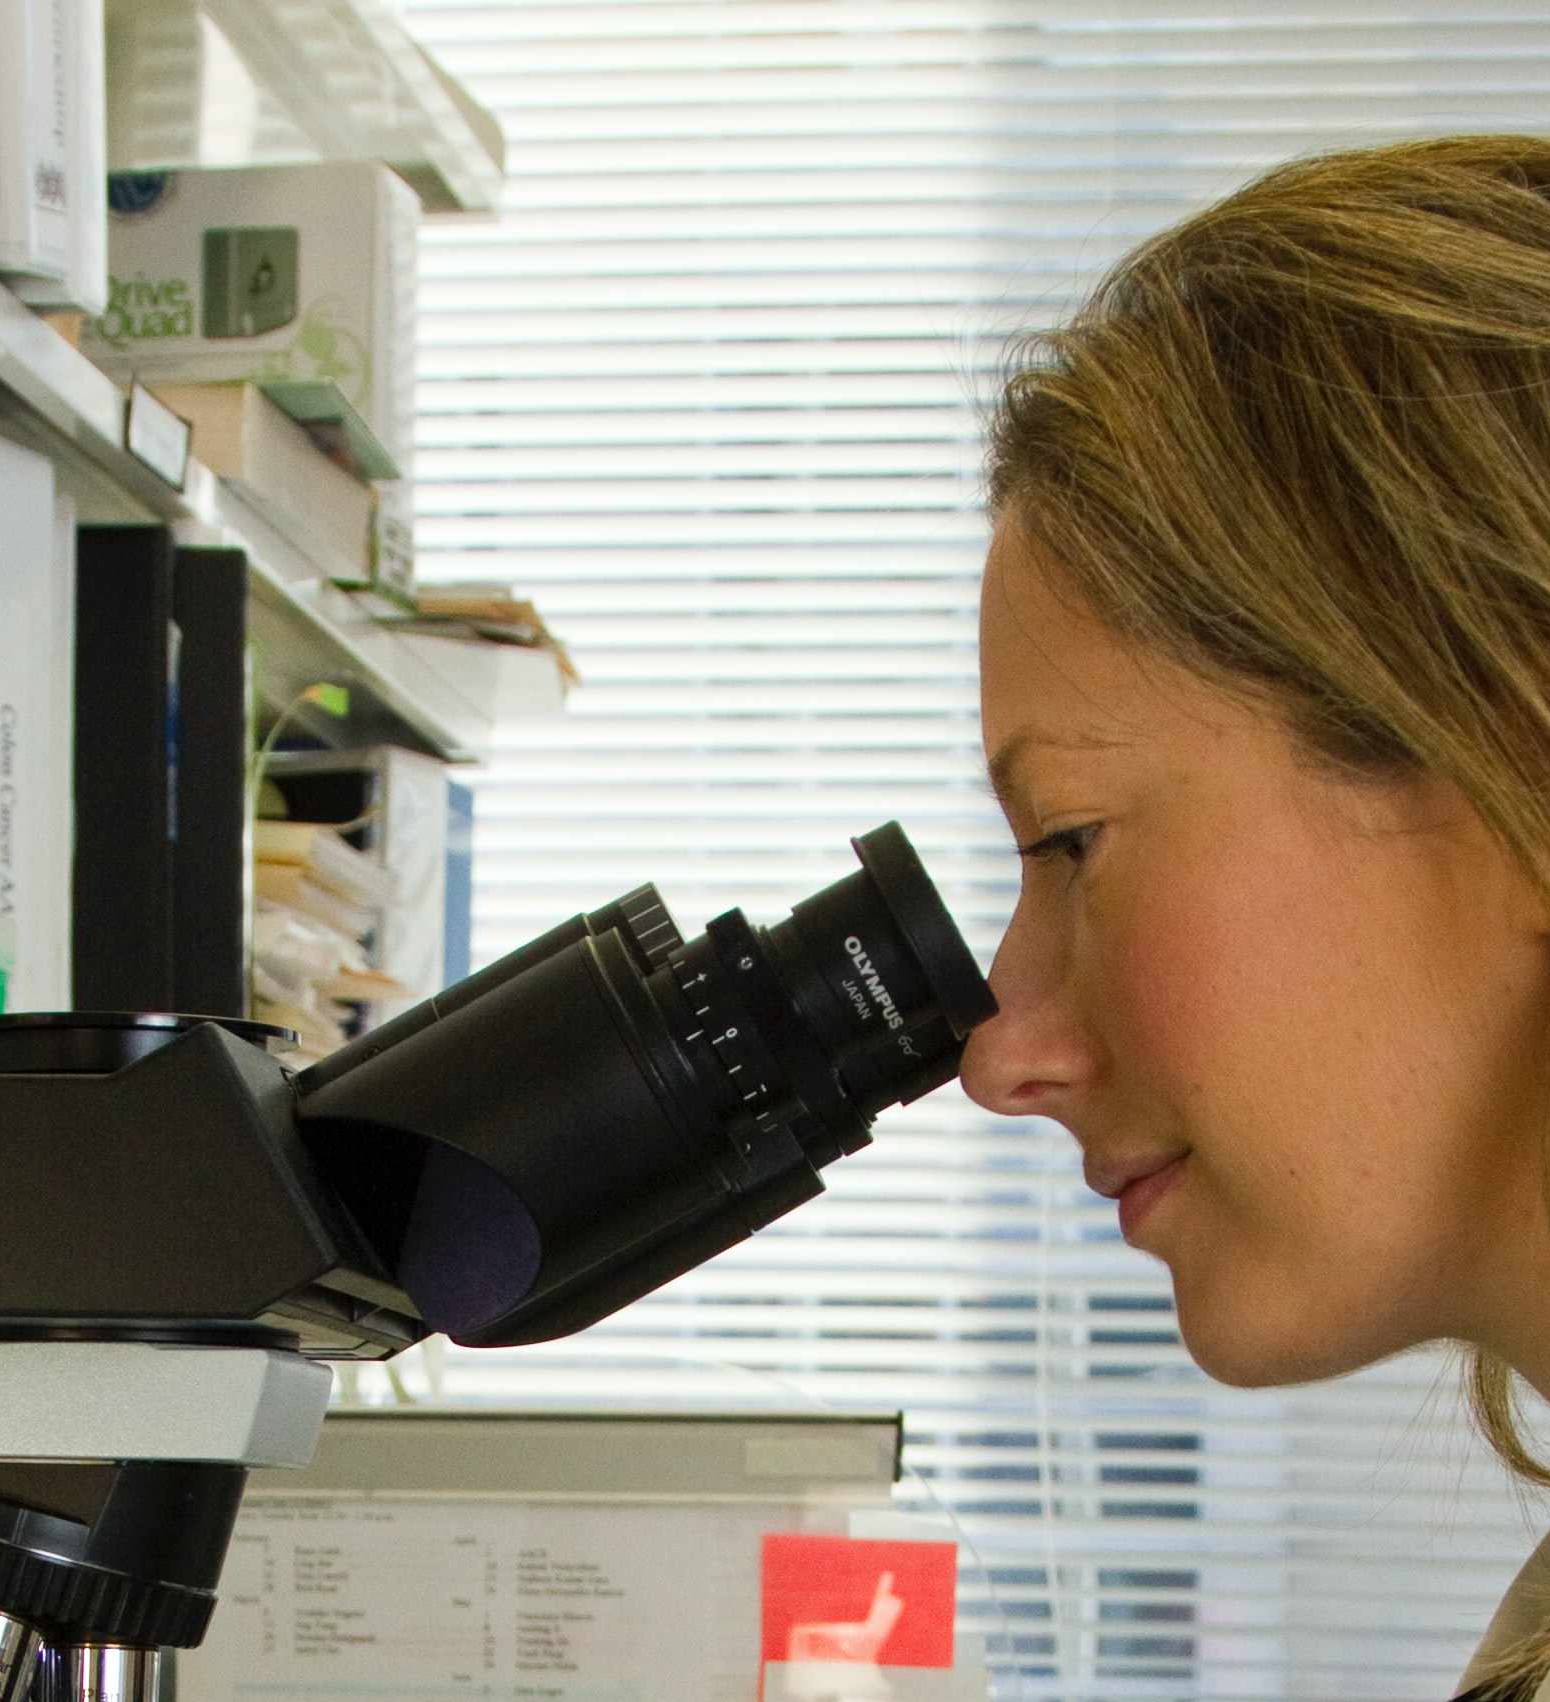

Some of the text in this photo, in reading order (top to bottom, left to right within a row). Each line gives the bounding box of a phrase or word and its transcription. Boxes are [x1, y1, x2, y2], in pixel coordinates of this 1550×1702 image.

[99, 300, 193, 350] Quad
[0, 703, 17, 777] Colon
[0, 784, 17, 868] Cancer
[842, 979, 873, 1020] JAPAN
[844, 936, 904, 1030] OLYMPUS
